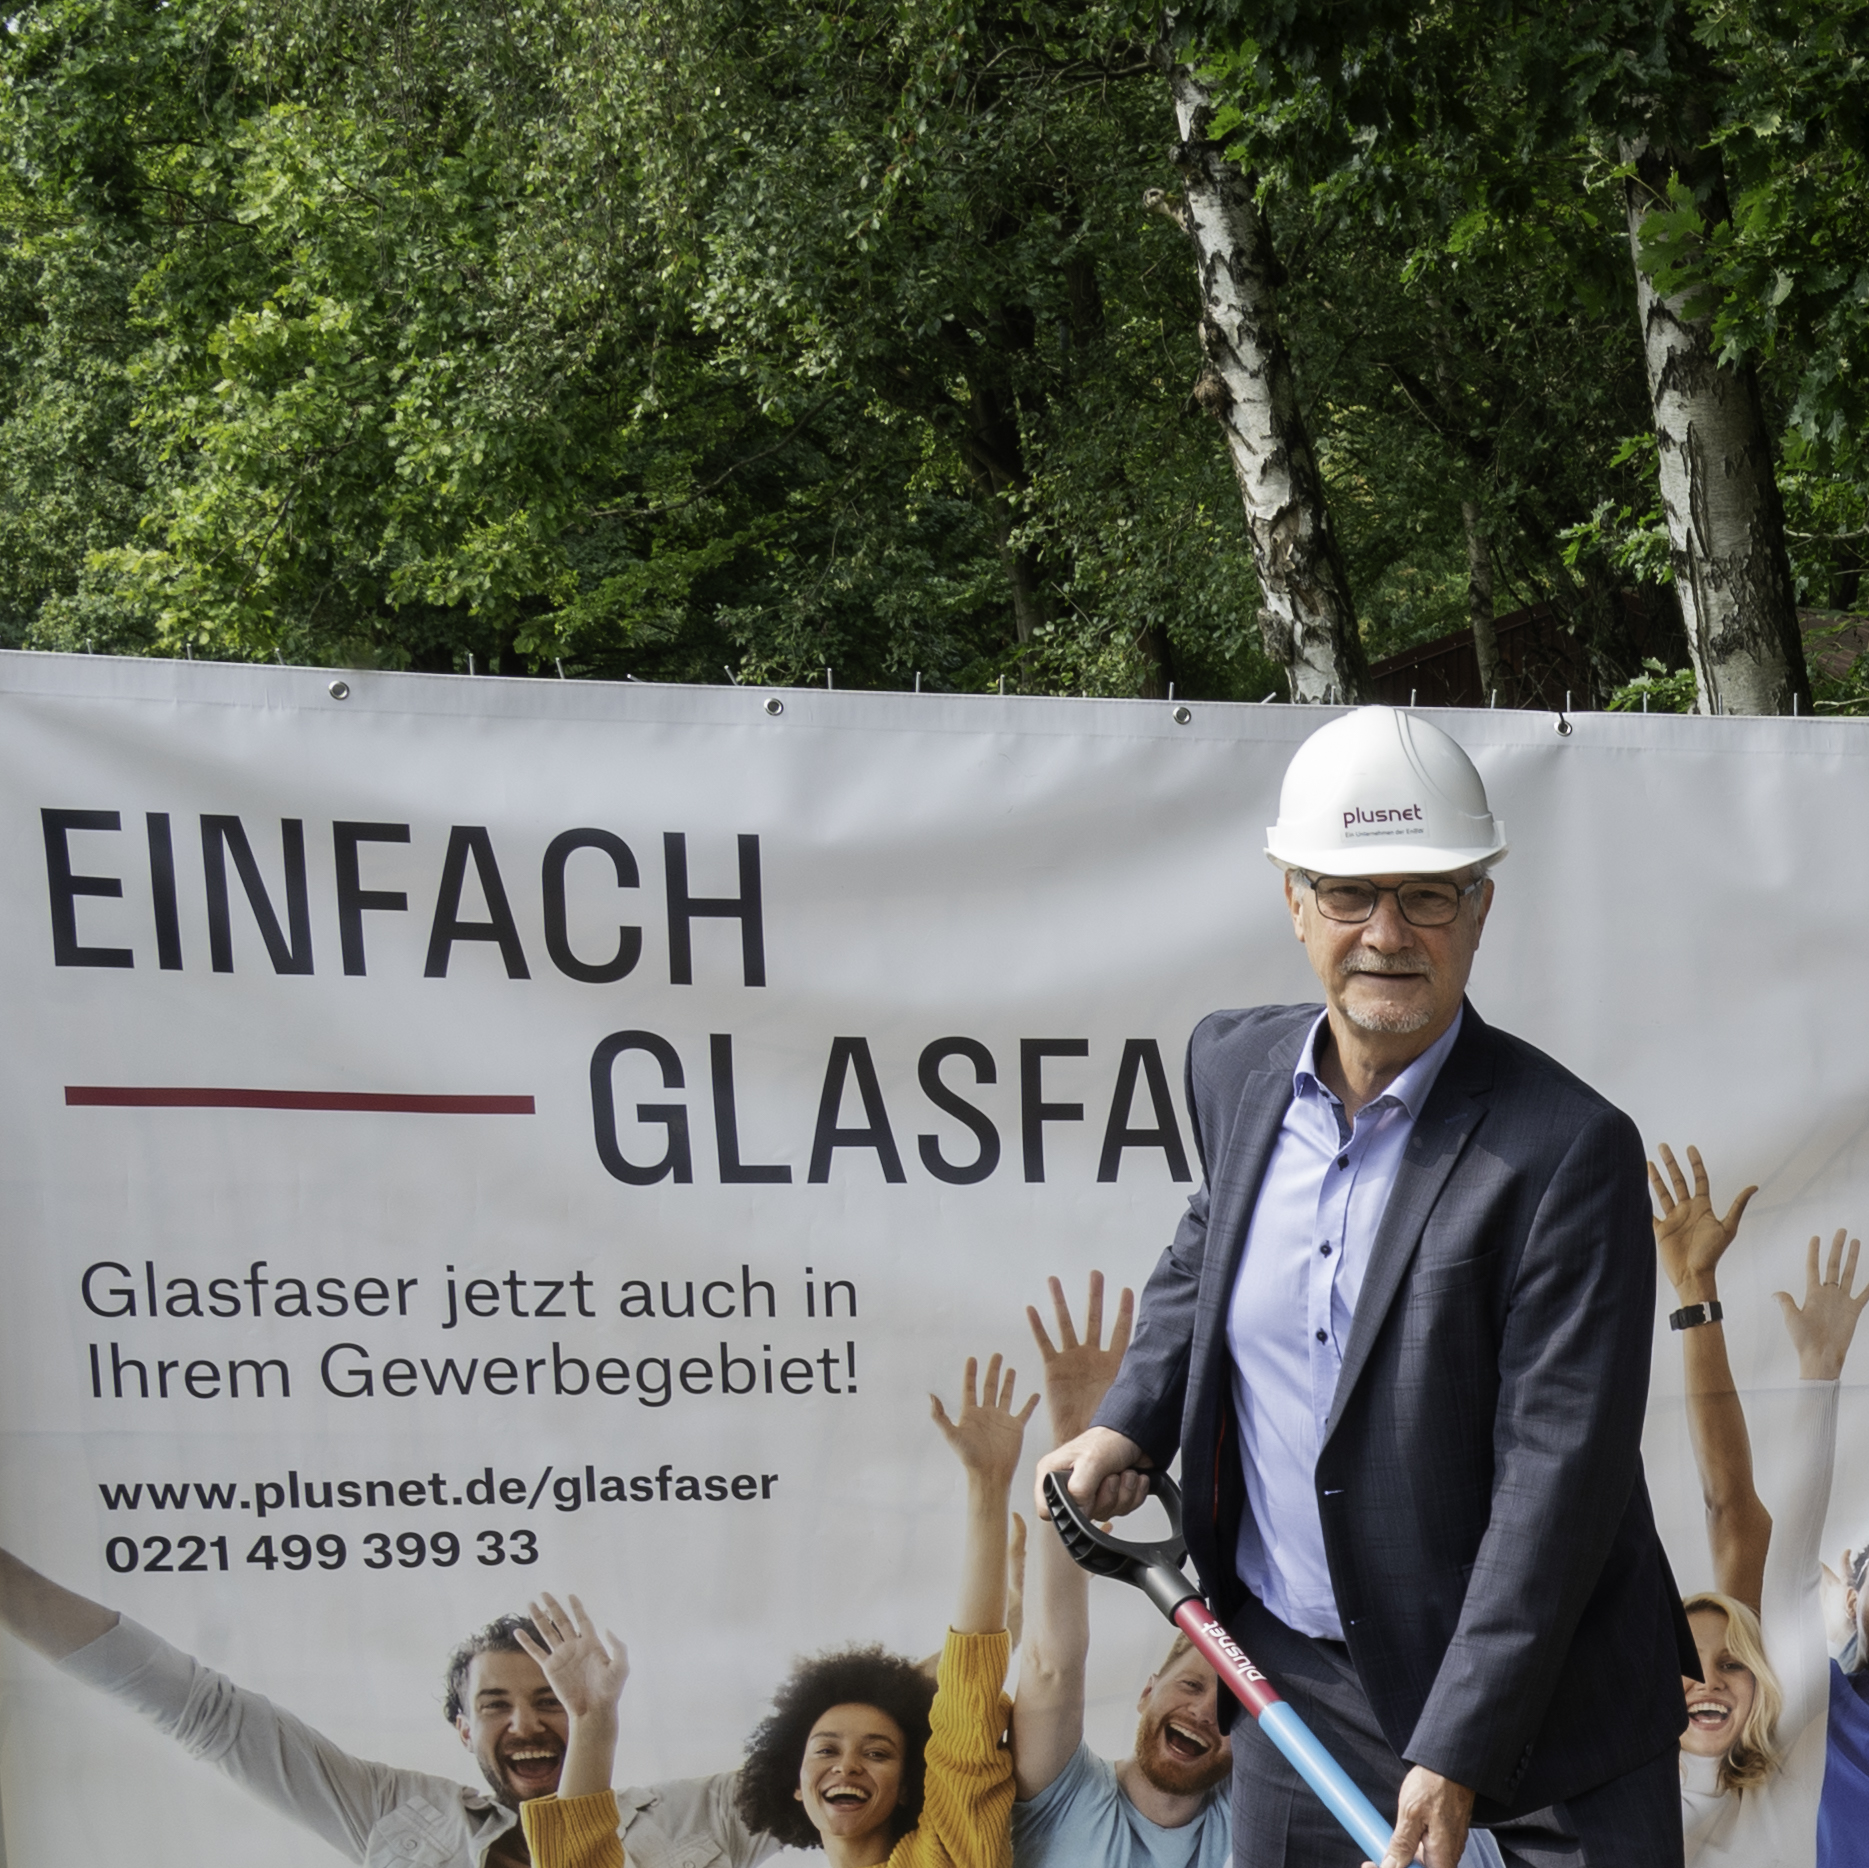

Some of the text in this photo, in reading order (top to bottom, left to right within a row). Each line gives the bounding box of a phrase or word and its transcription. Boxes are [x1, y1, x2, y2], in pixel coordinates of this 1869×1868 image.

[1343, 803, 1423, 828] plusnet
[40, 806, 767, 989] EINFACH
[590, 1029, 1193, 1186] GLASFA
[81, 1260, 858, 1330] Glasfaser jetzt auch in
[88, 1341, 858, 1408] Ihrem Gewerbegebiet!
[98, 1465, 780, 1518] www.plusnet.de/glasfaser
[105, 1529, 540, 1574] 0221 499 399 33
[1201, 1620, 1268, 1682] plusnet
